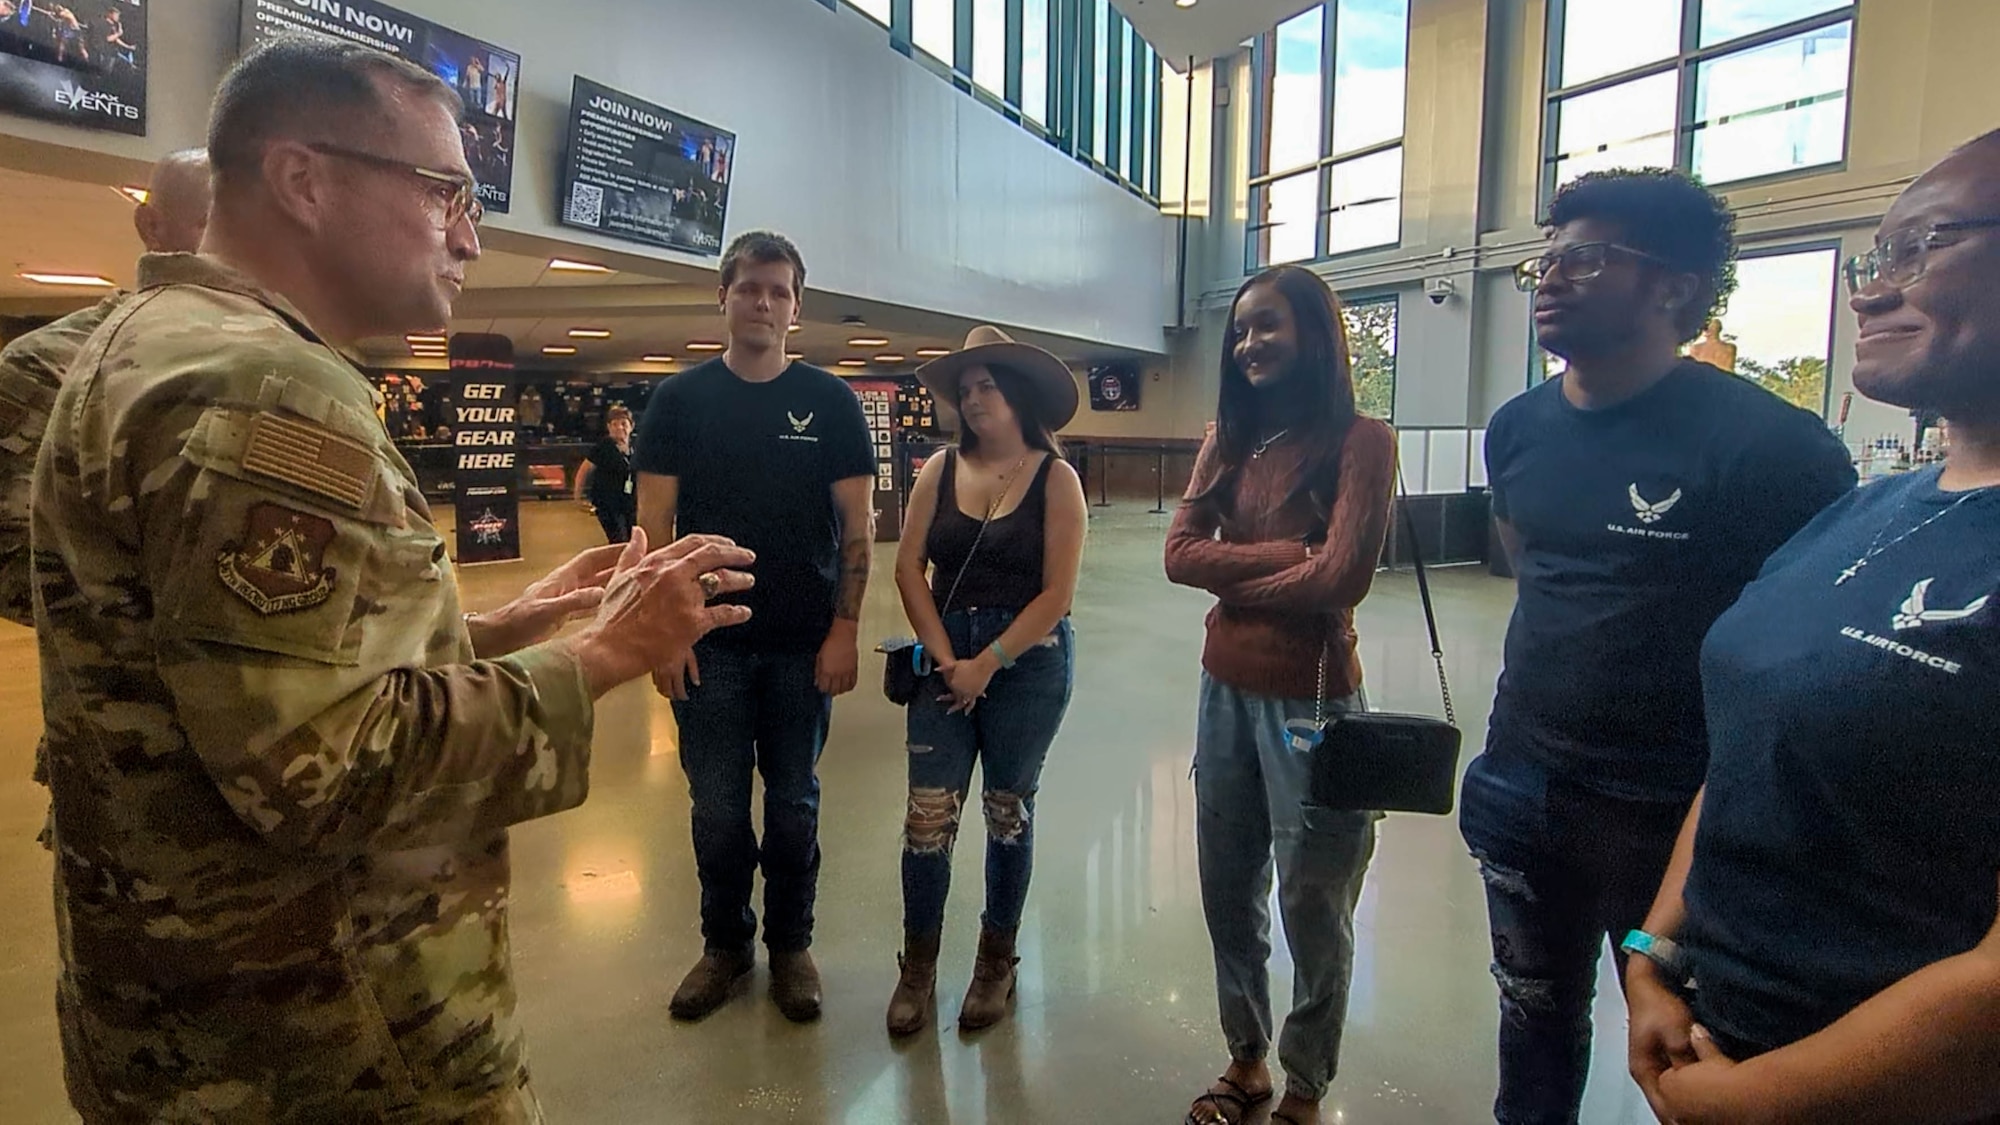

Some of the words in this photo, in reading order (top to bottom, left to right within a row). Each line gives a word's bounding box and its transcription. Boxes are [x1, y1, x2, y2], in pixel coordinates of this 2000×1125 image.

[256, 0, 320, 27] PREMIUM
[321, 20, 400, 52] MEMBERSHIP
[346, 6, 413, 43] NOW!
[55, 80, 139, 119] EVENTS
[91, 91, 119, 102] JAX
[589, 96, 630, 119] JOIN
[631, 108, 673, 133] NOW!
[478, 186, 507, 202] ENTS
[463, 383, 506, 399] GET
[456, 407, 515, 423] YOUR
[456, 430, 516, 446] GEAR
[458, 453, 516, 469] HERE
[1607, 523, 1625, 533] U.S.
[1626, 527, 1646, 536] AIR
[1647, 530, 1689, 539] FORCE
[1861, 634, 1888, 649] AIR
[1886, 641, 1961, 674] FORCE
